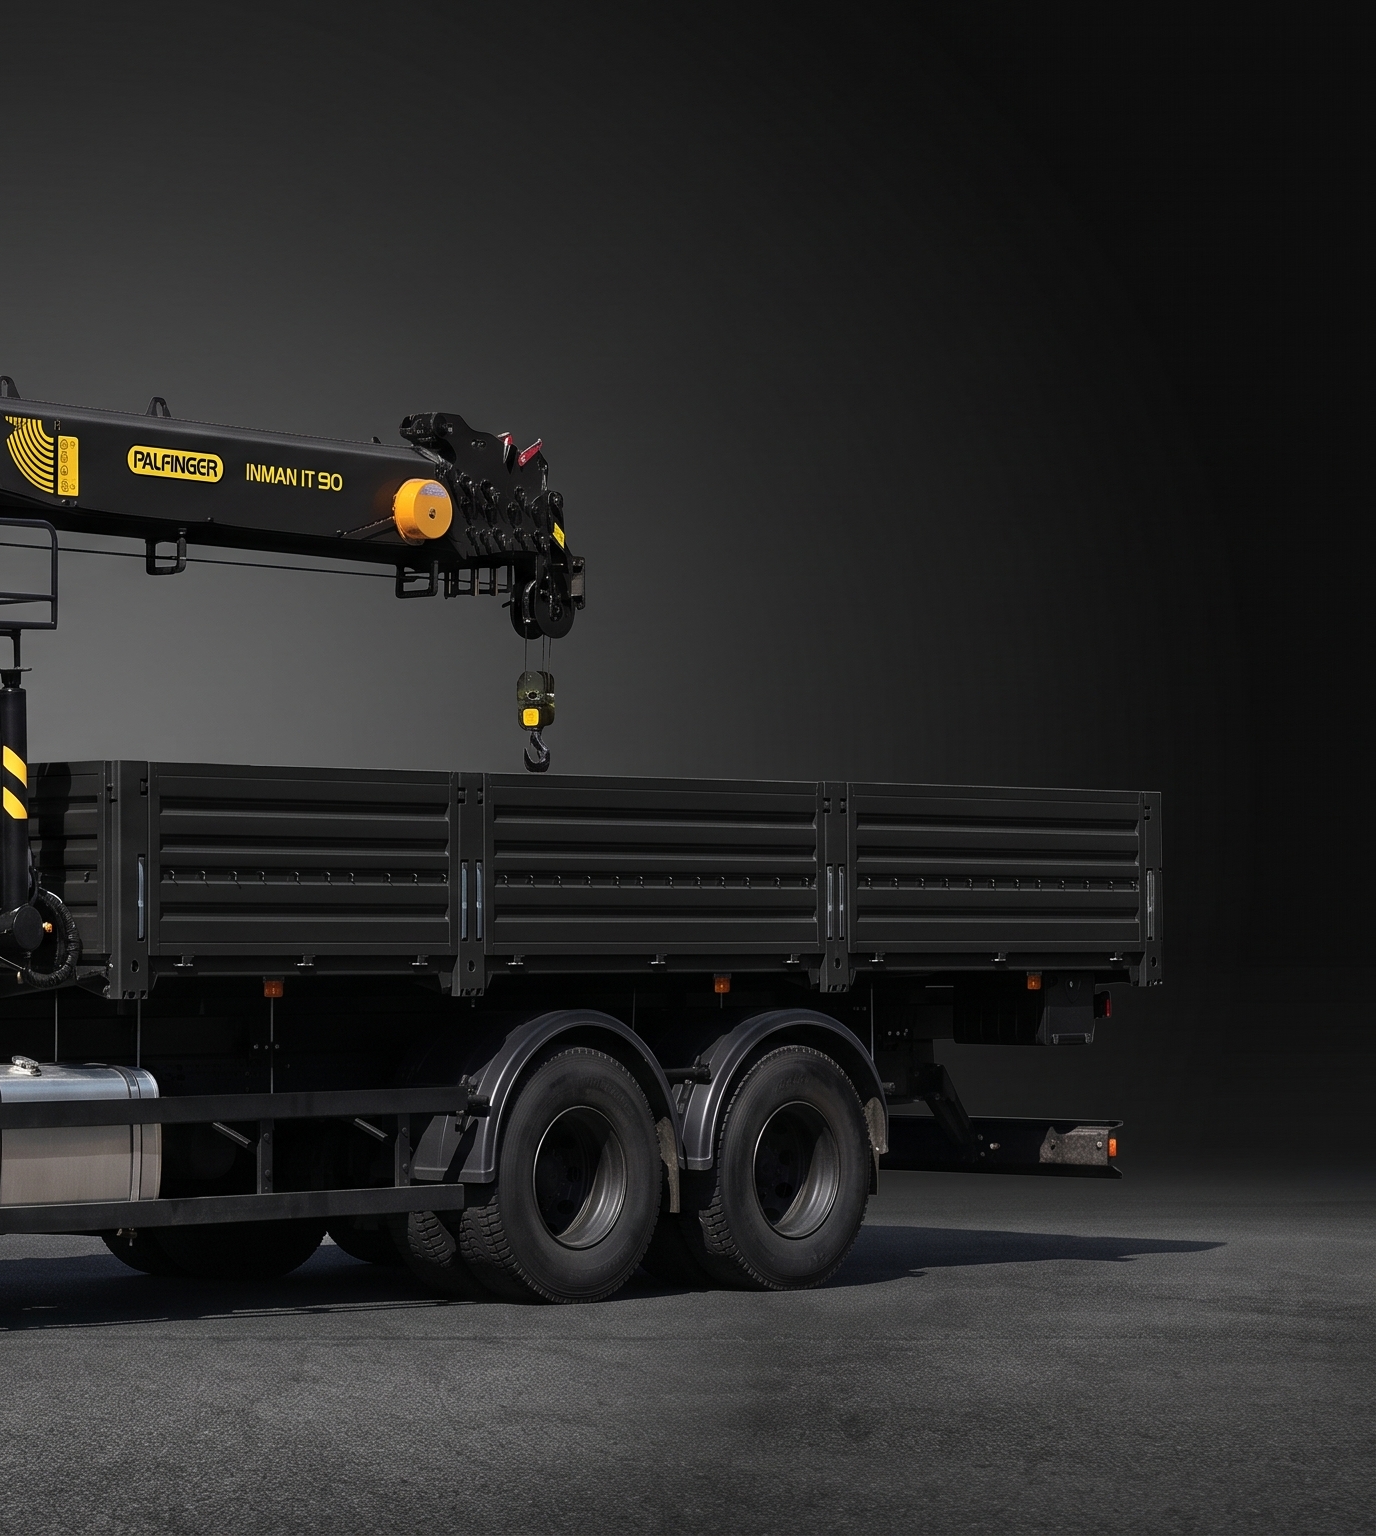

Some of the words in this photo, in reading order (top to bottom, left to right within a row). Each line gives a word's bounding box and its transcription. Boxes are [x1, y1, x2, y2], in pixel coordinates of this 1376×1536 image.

[133, 450, 218, 477] PALFINGER
[246, 463, 297, 487] INMAN
[301, 469, 315, 488] IT
[318, 472, 343, 492] 90
